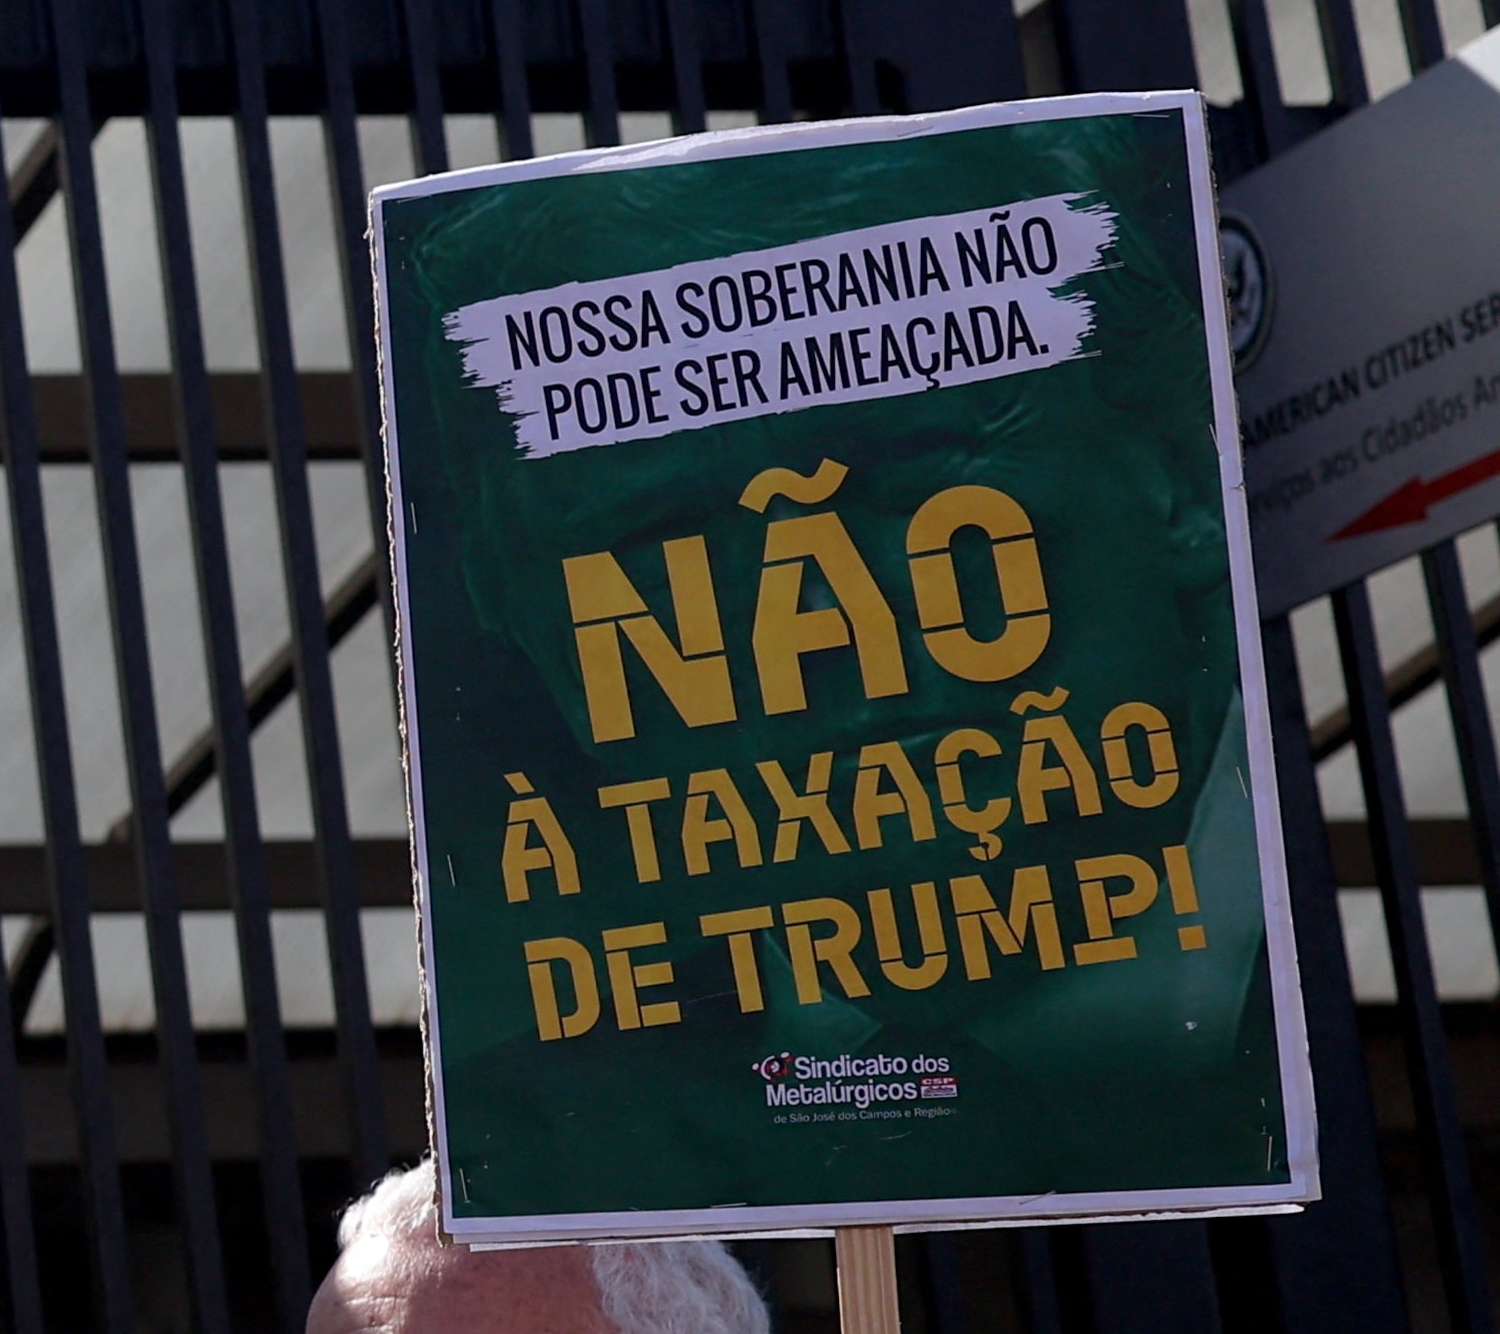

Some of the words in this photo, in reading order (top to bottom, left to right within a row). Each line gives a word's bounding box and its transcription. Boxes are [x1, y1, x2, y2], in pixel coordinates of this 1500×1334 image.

[504, 289, 672, 372] NOSSA
[673, 238, 949, 343] SOBERANIA
[953, 210, 1060, 291] NÃO
[1363, 318, 1457, 390] CITIZEN
[541, 368, 672, 441] PODE
[677, 347, 765, 418] SER
[777, 300, 1050, 401] AMEAÇADA.
[562, 457, 1052, 744] NÃO
[501, 770, 583, 905] À
[597, 685, 1181, 885] TAXAÇÃO
[523, 921, 683, 1042] DE
[700, 843, 1208, 1015] TRUMP!
[766, 1079, 918, 1109] Metalúrgicos
[774, 1113, 787, 1124] de
[812, 1111, 835, 1122] José
[838, 1110, 857, 1121] dos
[859, 1108, 902, 1121] Campos
[794, 1053, 908, 1080] Sindicato
[912, 1053, 950, 1074] dos
